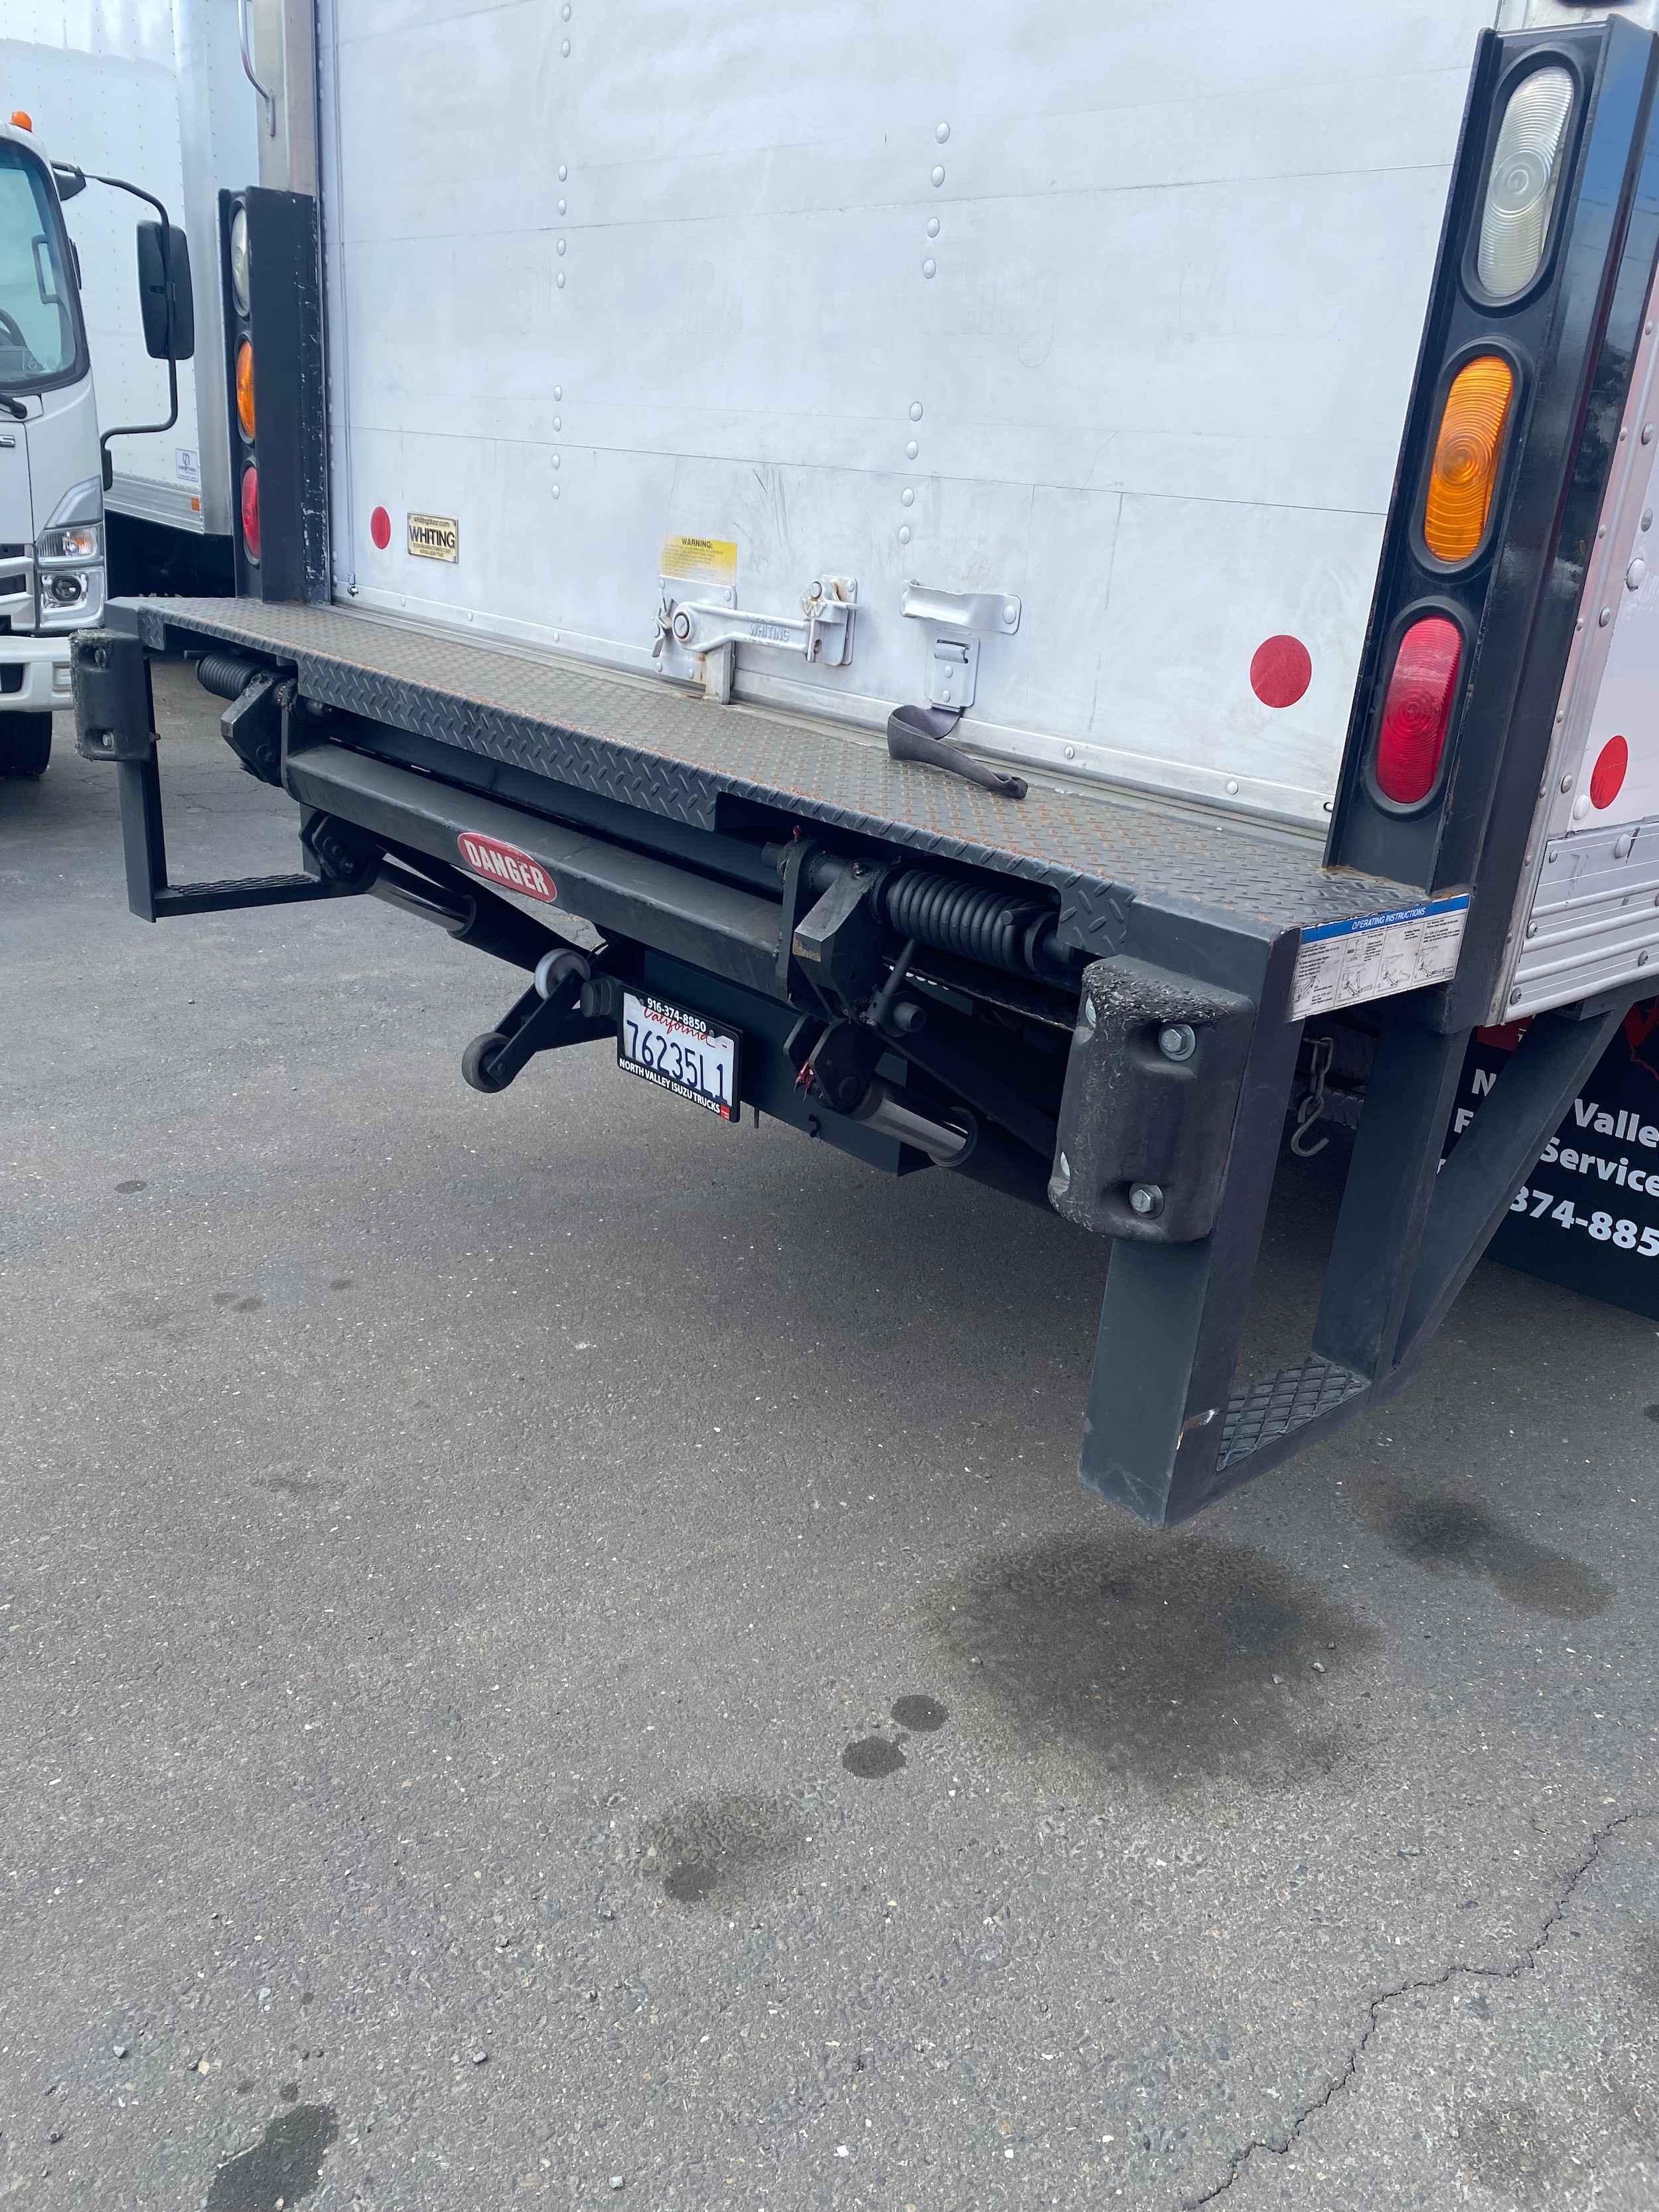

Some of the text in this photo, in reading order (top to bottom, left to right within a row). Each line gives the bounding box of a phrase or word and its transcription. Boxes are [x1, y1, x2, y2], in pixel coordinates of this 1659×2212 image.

[409, 525, 455, 549] WHITING
[682, 537, 713, 549] WARNING:
[749, 623, 790, 642] WHITING
[463, 839, 549, 896] DANGER
[1352, 916, 1385, 930] OPERATING
[1385, 907, 1426, 922] INSTRUCTIONS
[647, 997, 707, 1032] 916-374-8850
[626, 1019, 728, 1104] 76235L1
[619, 1058, 721, 1114] NORTH VALLEY ISUZU TRUCKS
